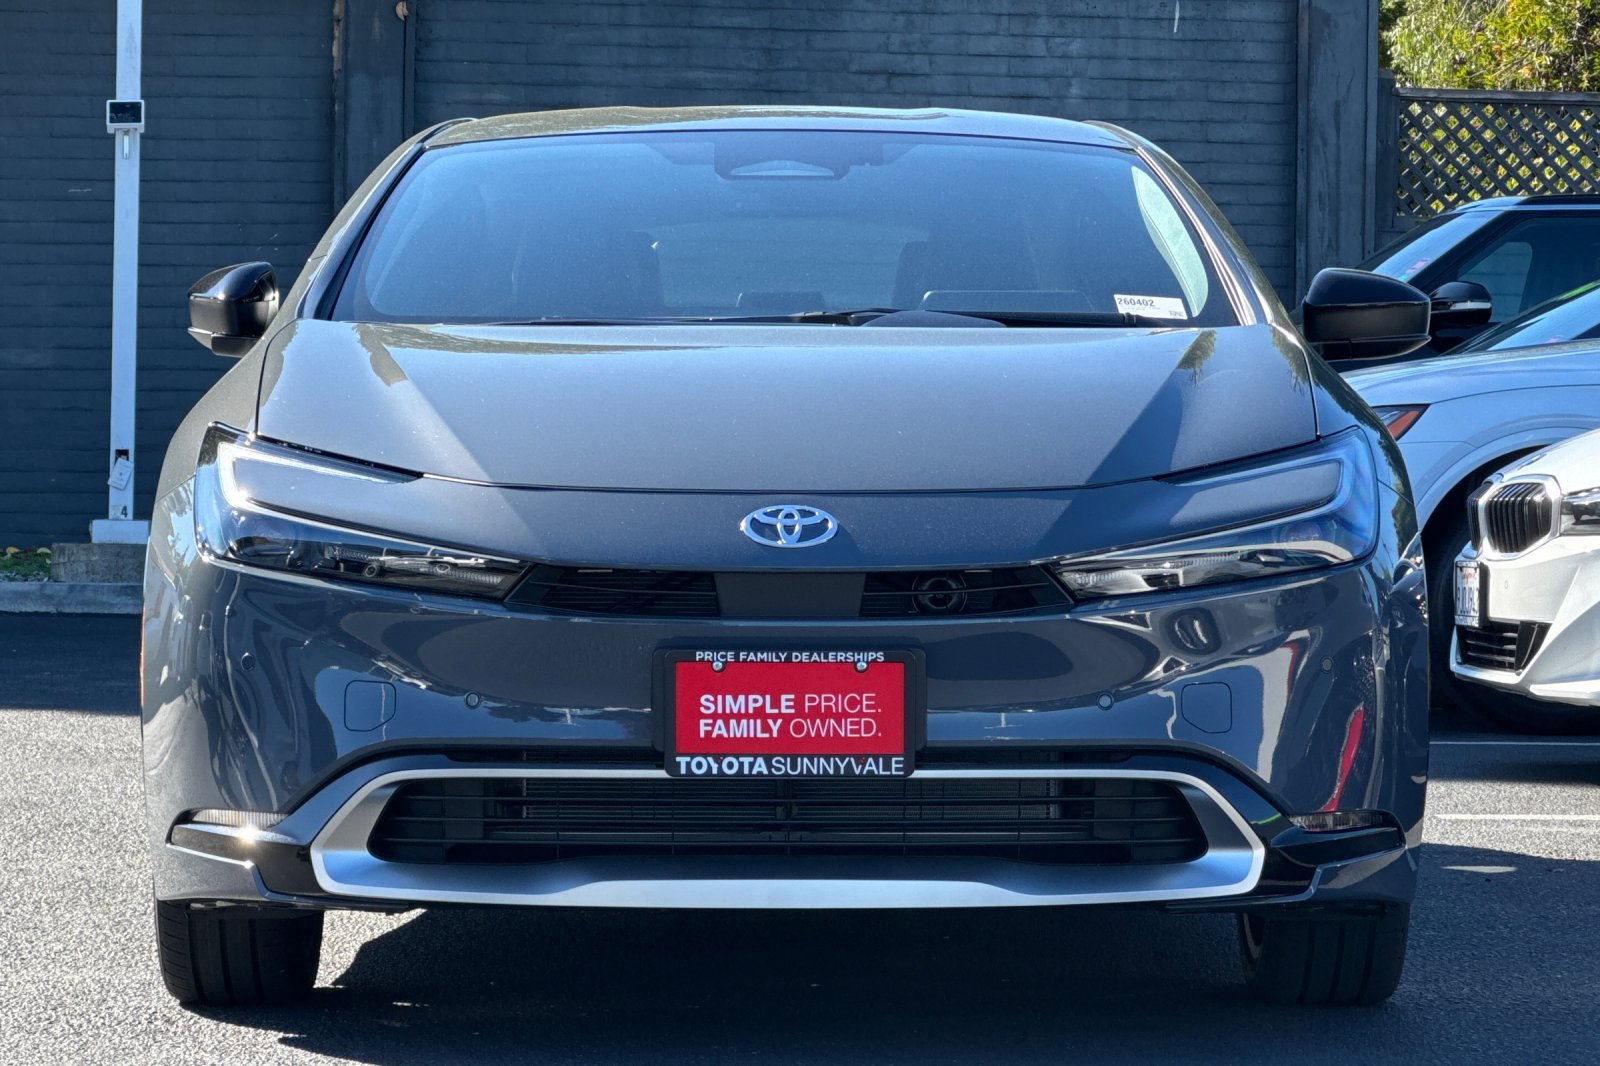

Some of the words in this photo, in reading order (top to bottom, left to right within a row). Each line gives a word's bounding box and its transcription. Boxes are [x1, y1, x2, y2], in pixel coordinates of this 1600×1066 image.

[1117, 297, 1155, 307] 260402
[695, 651, 735, 662] PRICE
[739, 652, 788, 662] FAMILY
[791, 652, 885, 662] DEALERSHIPS
[699, 694, 796, 714] SIMPLE
[804, 693, 882, 713] PRICE.
[699, 718, 783, 738] FAMILY
[789, 717, 882, 738] OWNED.
[675, 756, 769, 775] TOYOTA
[770, 756, 905, 775] SUNNYVALE
